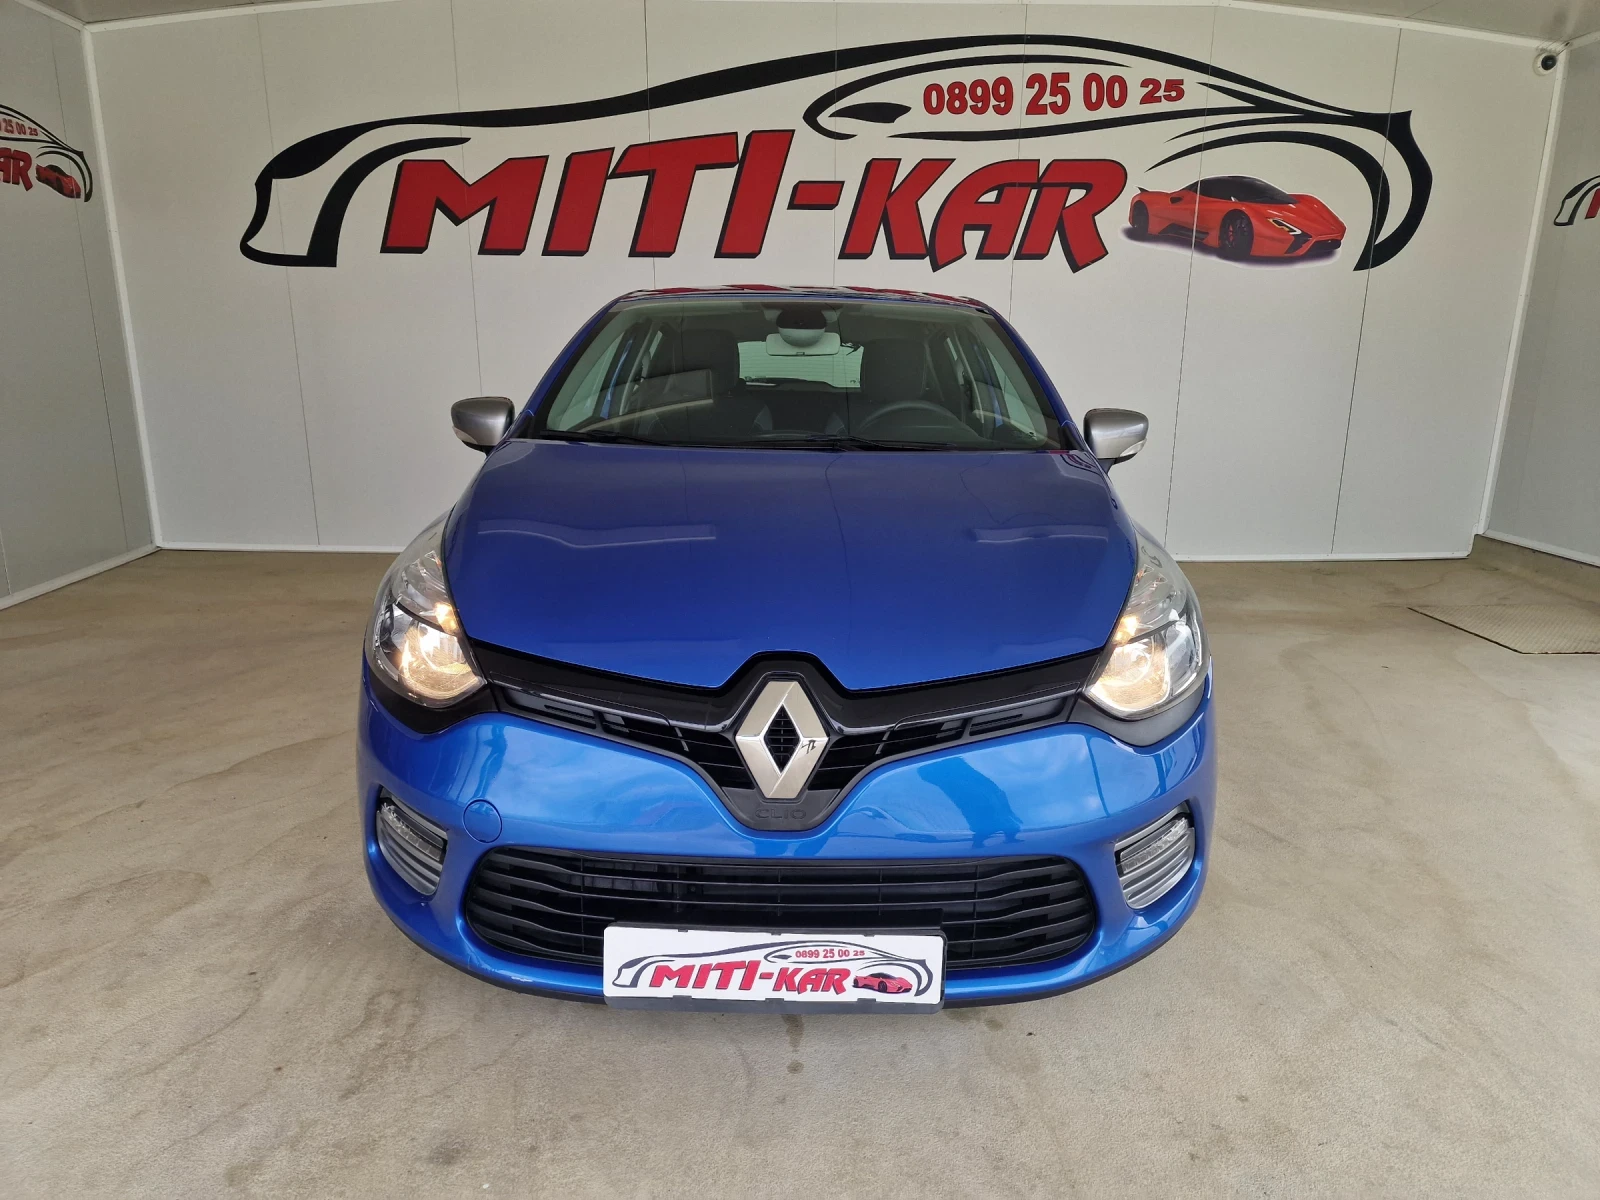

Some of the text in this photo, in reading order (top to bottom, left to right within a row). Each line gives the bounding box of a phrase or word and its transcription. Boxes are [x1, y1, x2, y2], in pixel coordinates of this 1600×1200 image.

[923, 72, 1185, 115] 0899 25 00 25
[3, 118, 14, 134] 25
[15, 122, 26, 135] 00
[28, 126, 38, 136] 25
[380, 129, 1128, 273] MITI-KAR
[795, 949, 820, 959] 0899
[822, 948, 835, 959] 25
[837, 948, 850, 958] 00
[649, 960, 851, 995] MITI-KAR
